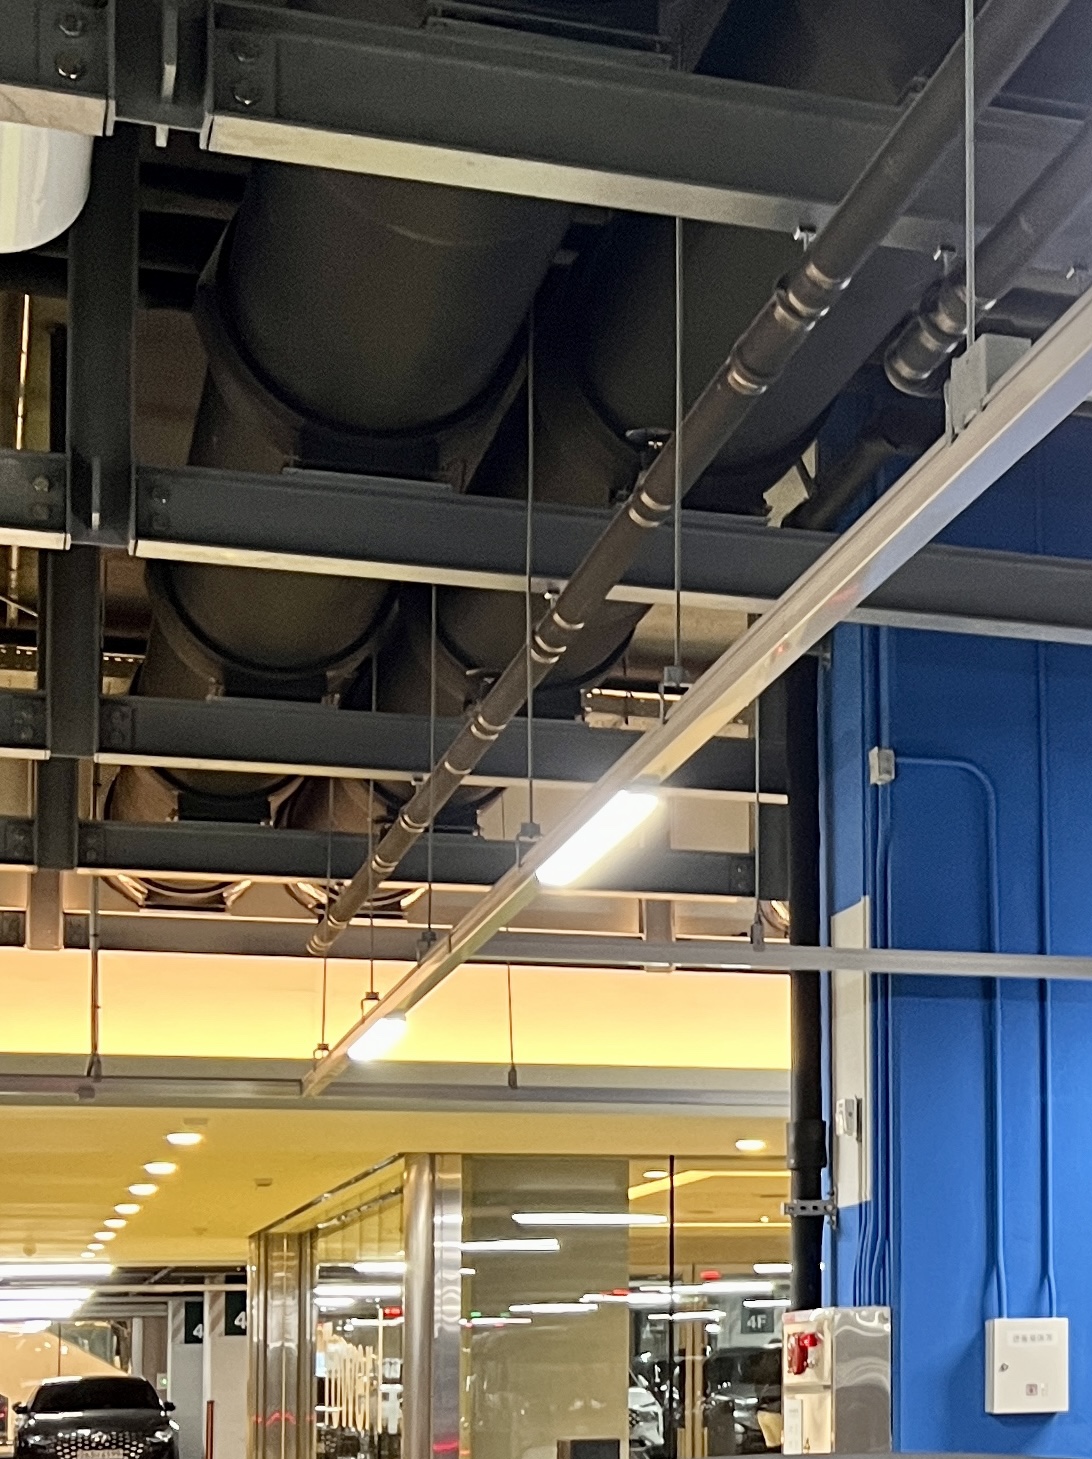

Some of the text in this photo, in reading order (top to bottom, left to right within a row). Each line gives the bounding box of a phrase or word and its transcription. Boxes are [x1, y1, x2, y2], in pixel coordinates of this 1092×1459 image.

[234, 1311, 249, 1330] 4
[746, 1314, 767, 1329] 4F
[192, 1323, 203, 1339] 4
